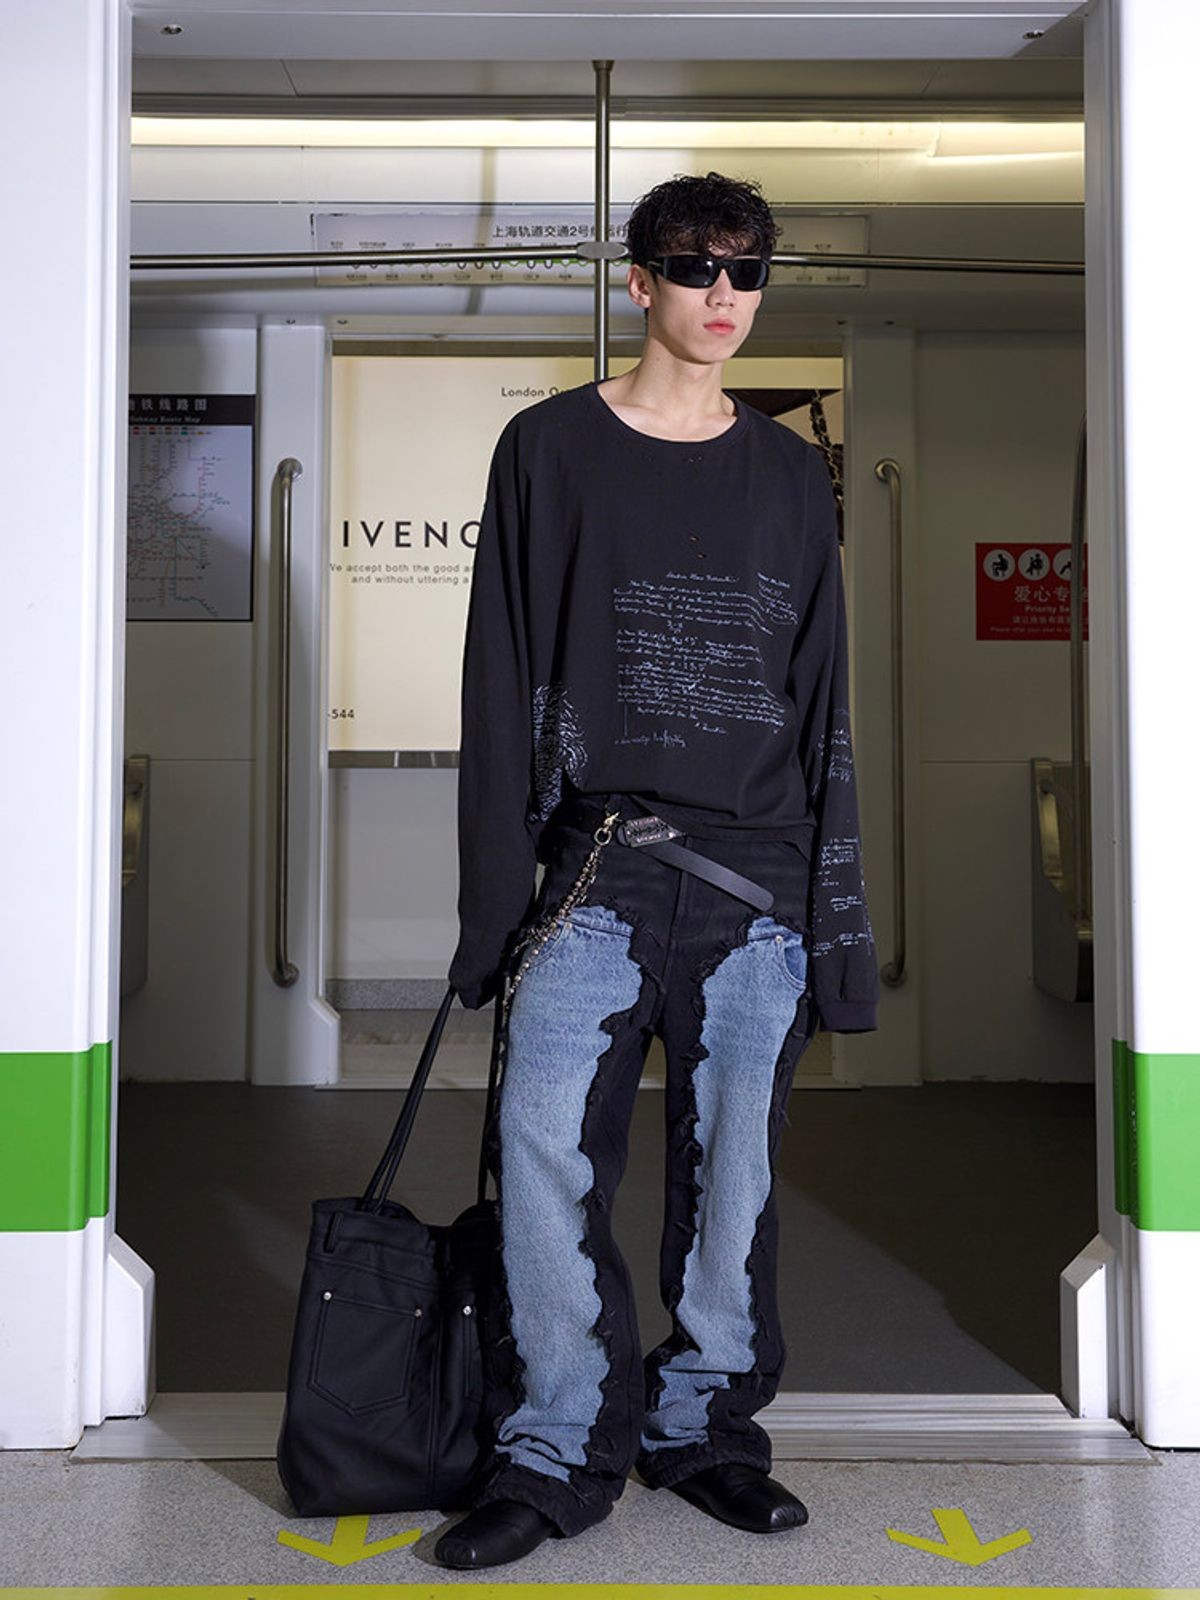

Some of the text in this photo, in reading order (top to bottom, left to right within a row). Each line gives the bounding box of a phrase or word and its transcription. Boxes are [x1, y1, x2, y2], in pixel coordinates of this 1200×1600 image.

[501, 387, 545, 397] London
[346, 563, 382, 573] accept
[386, 563, 409, 572] both
[412, 563, 430, 572] the
[434, 563, 460, 573] good
[352, 575, 371, 584] and
[375, 575, 414, 584] without
[417, 575, 459, 585] uttering
[1024, 604, 1056, 614] Priority
